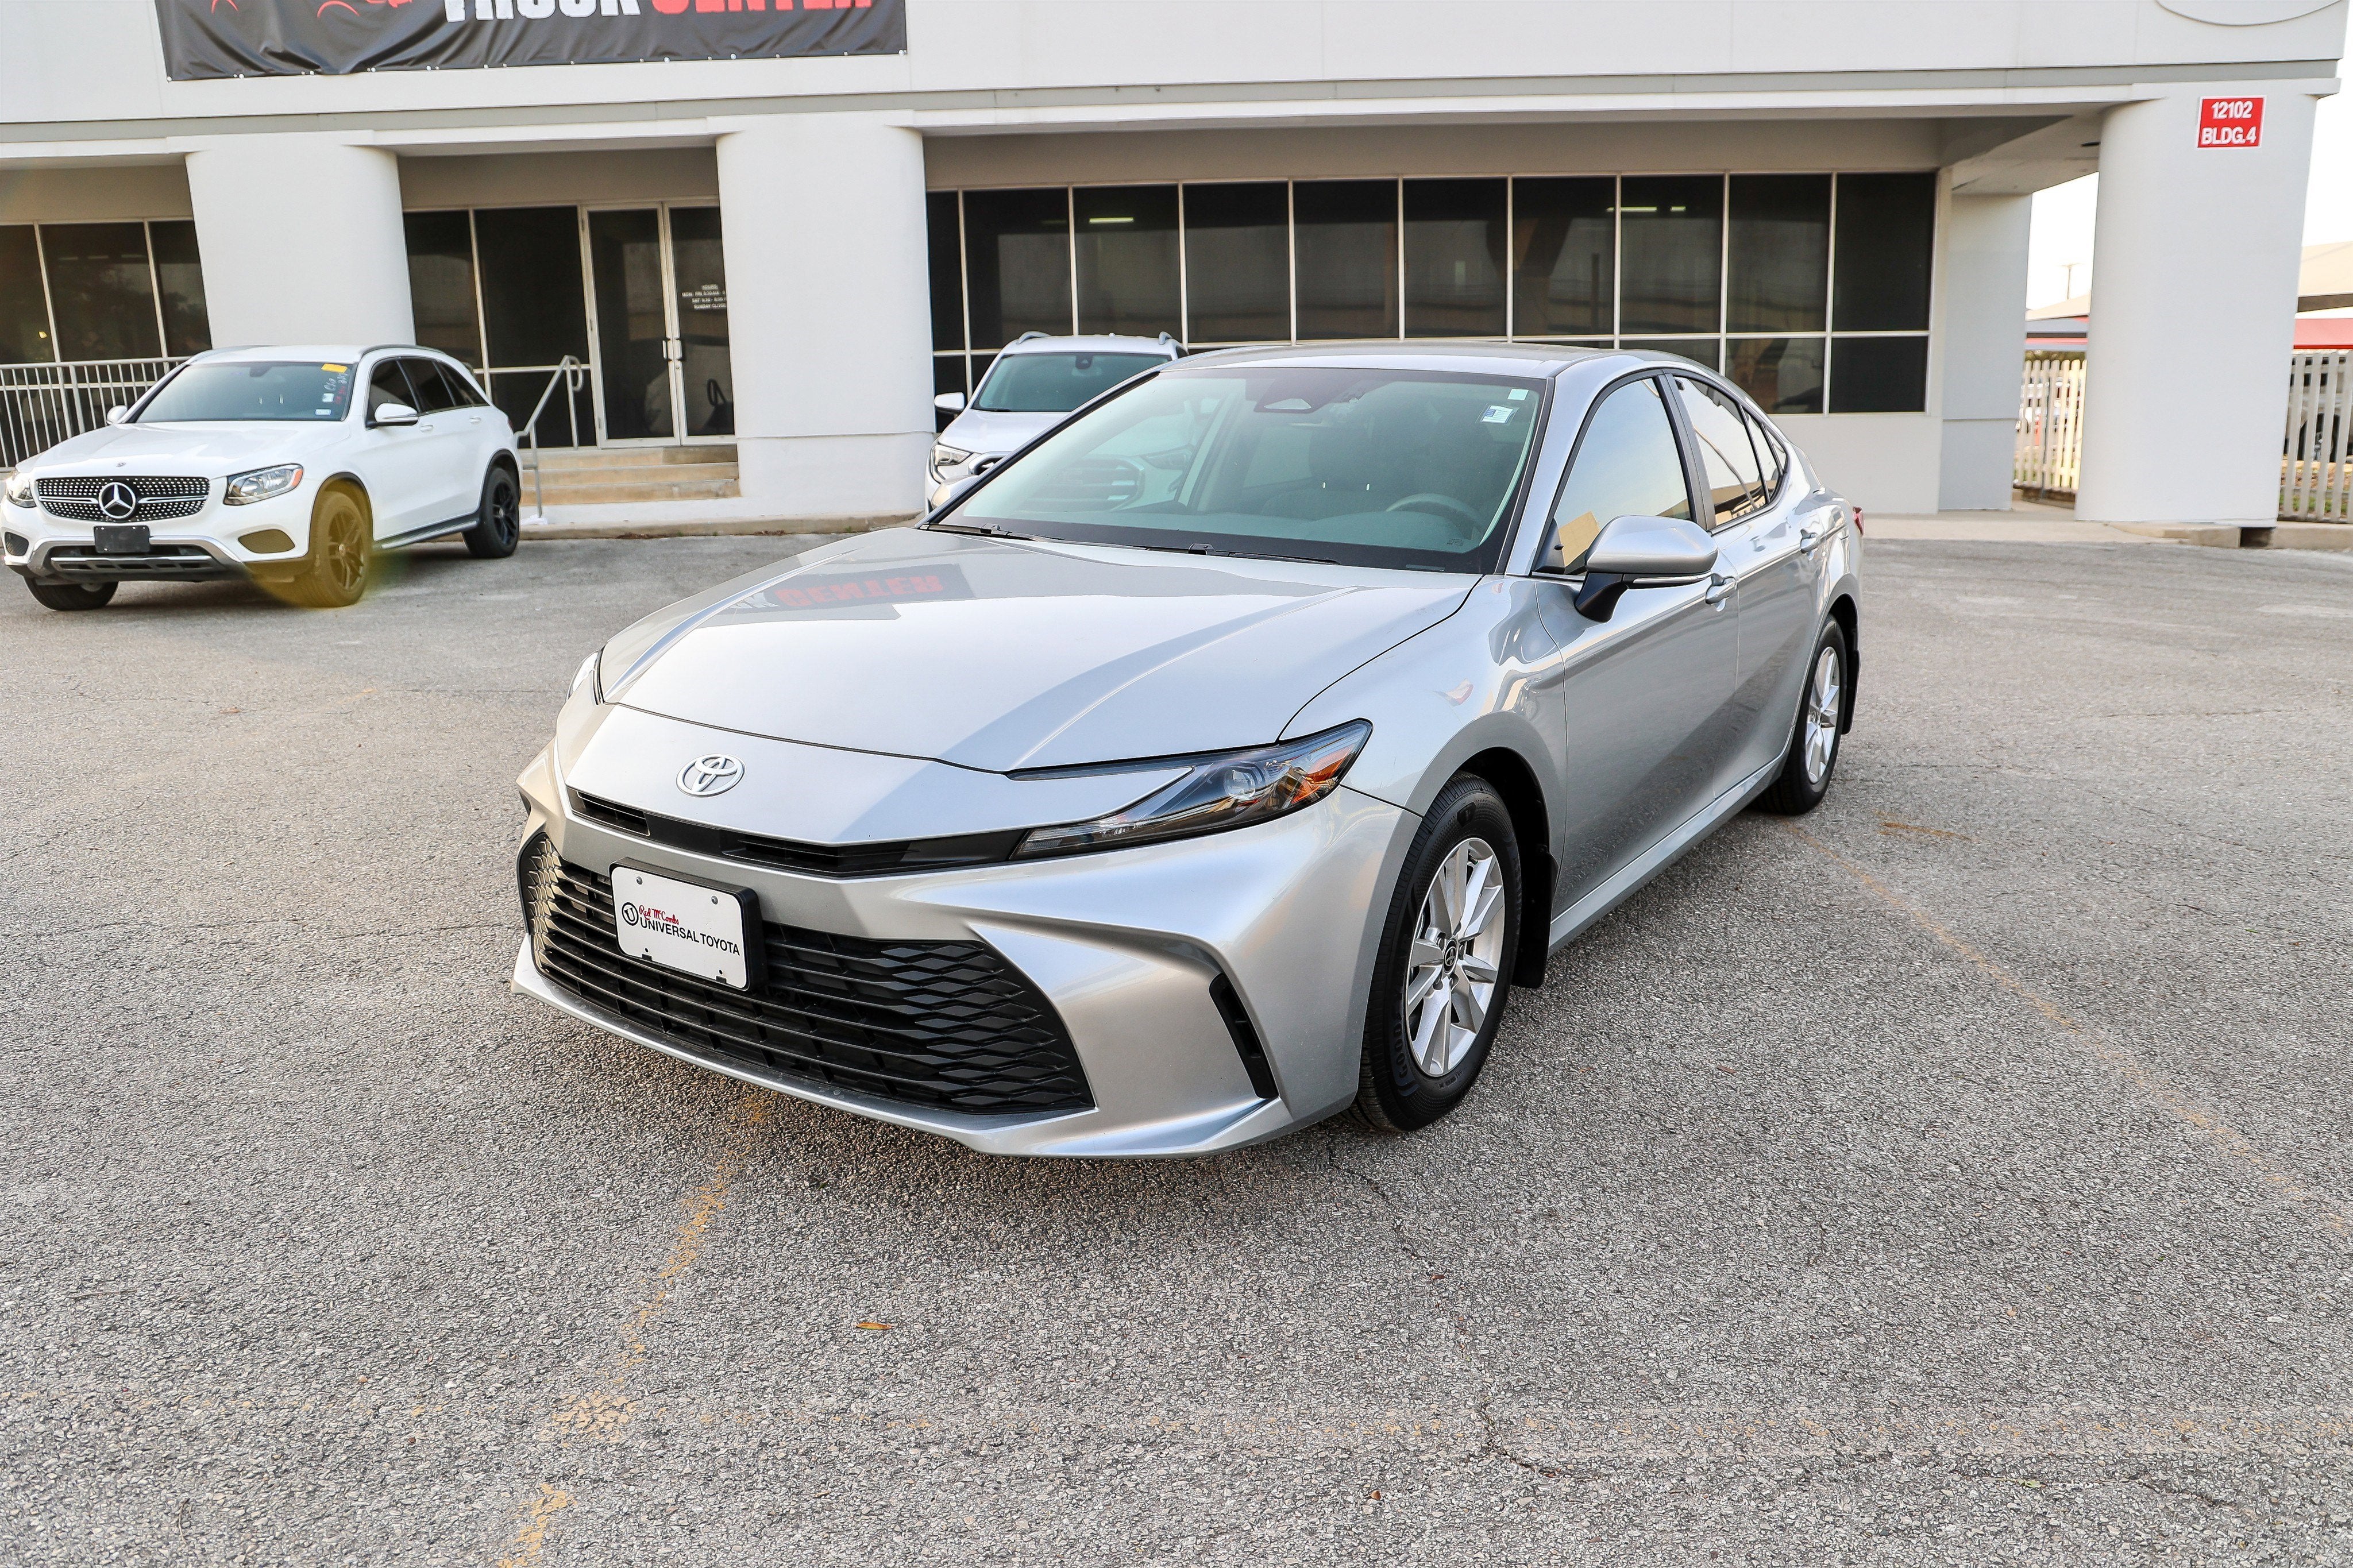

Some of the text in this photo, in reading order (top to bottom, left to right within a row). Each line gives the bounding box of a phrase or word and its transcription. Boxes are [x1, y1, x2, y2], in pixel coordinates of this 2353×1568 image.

[2211, 100, 2253, 119] 12102
[639, 905, 679, 925] Red McCombs
[640, 917, 740, 956] UNIVERSAL TOYOTA
